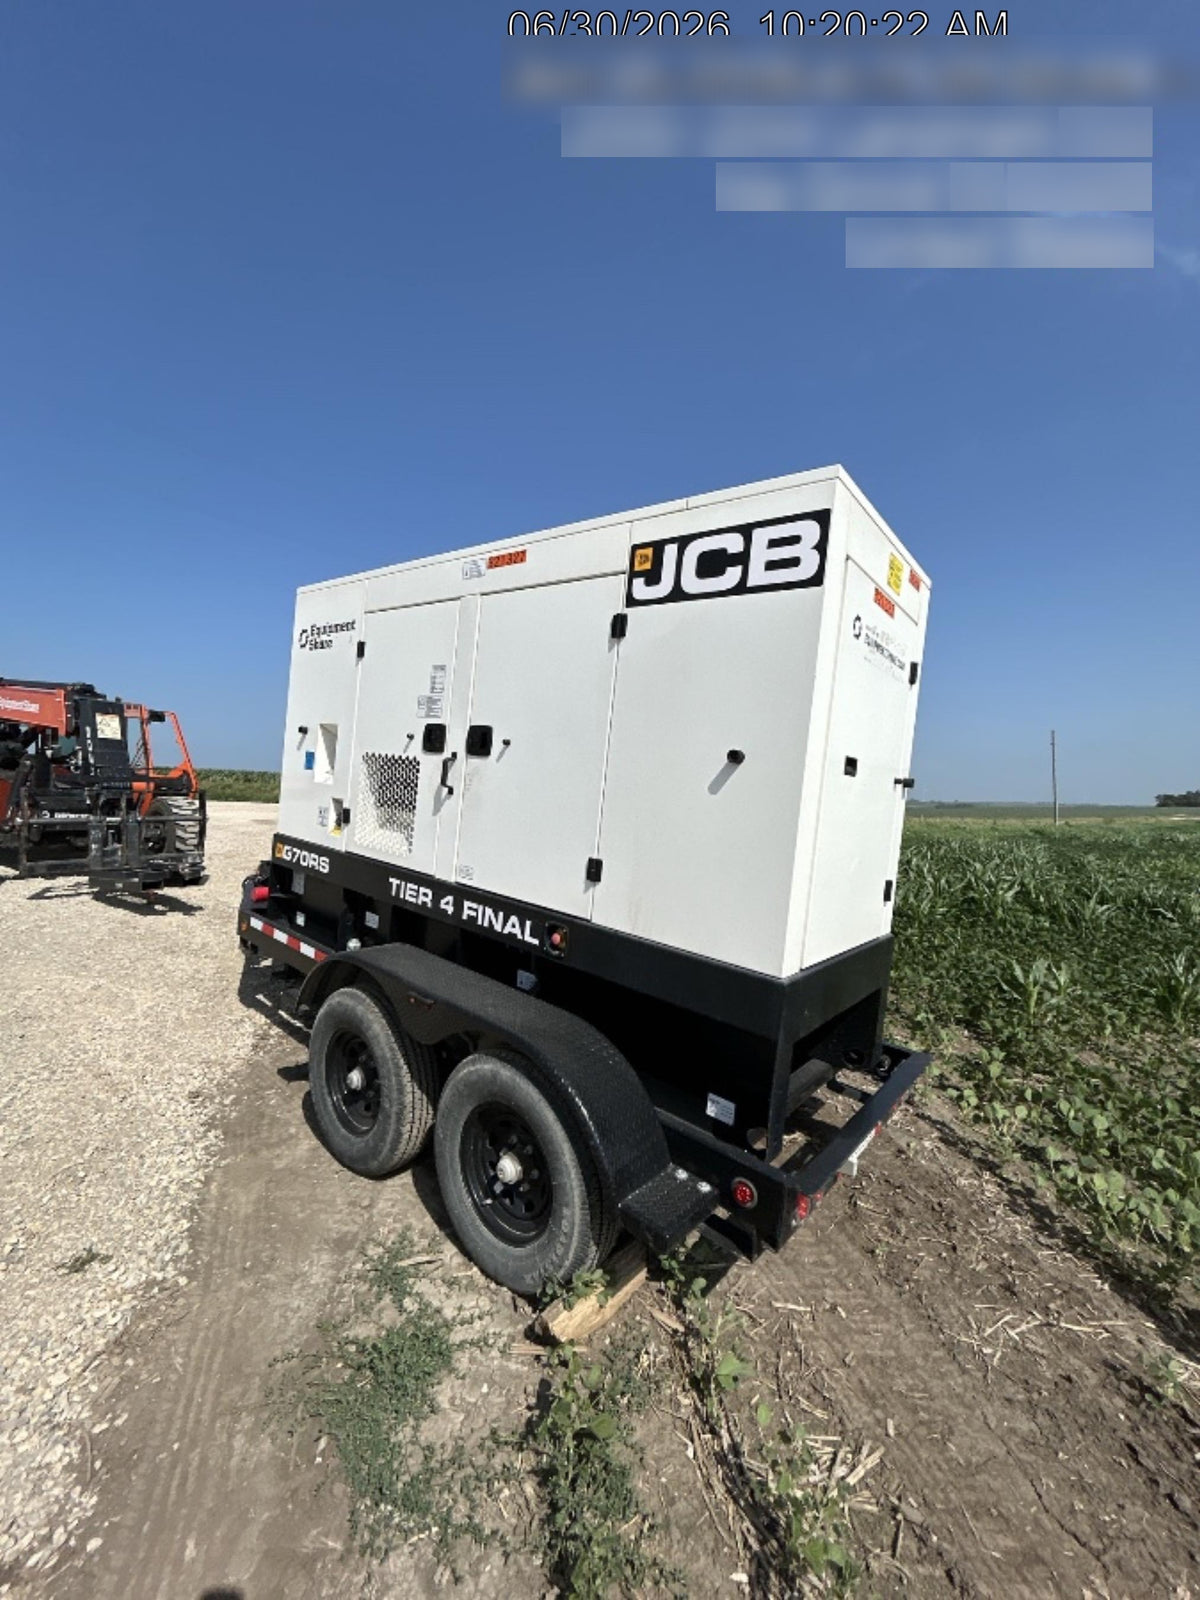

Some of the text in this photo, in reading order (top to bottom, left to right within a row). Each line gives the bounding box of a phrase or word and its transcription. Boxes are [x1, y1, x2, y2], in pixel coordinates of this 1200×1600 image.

[631, 519, 822, 601] JCB
[310, 619, 356, 638] Equipment
[283, 845, 330, 874] G70RS
[388, 876, 540, 946] TIER 4 FINAL
